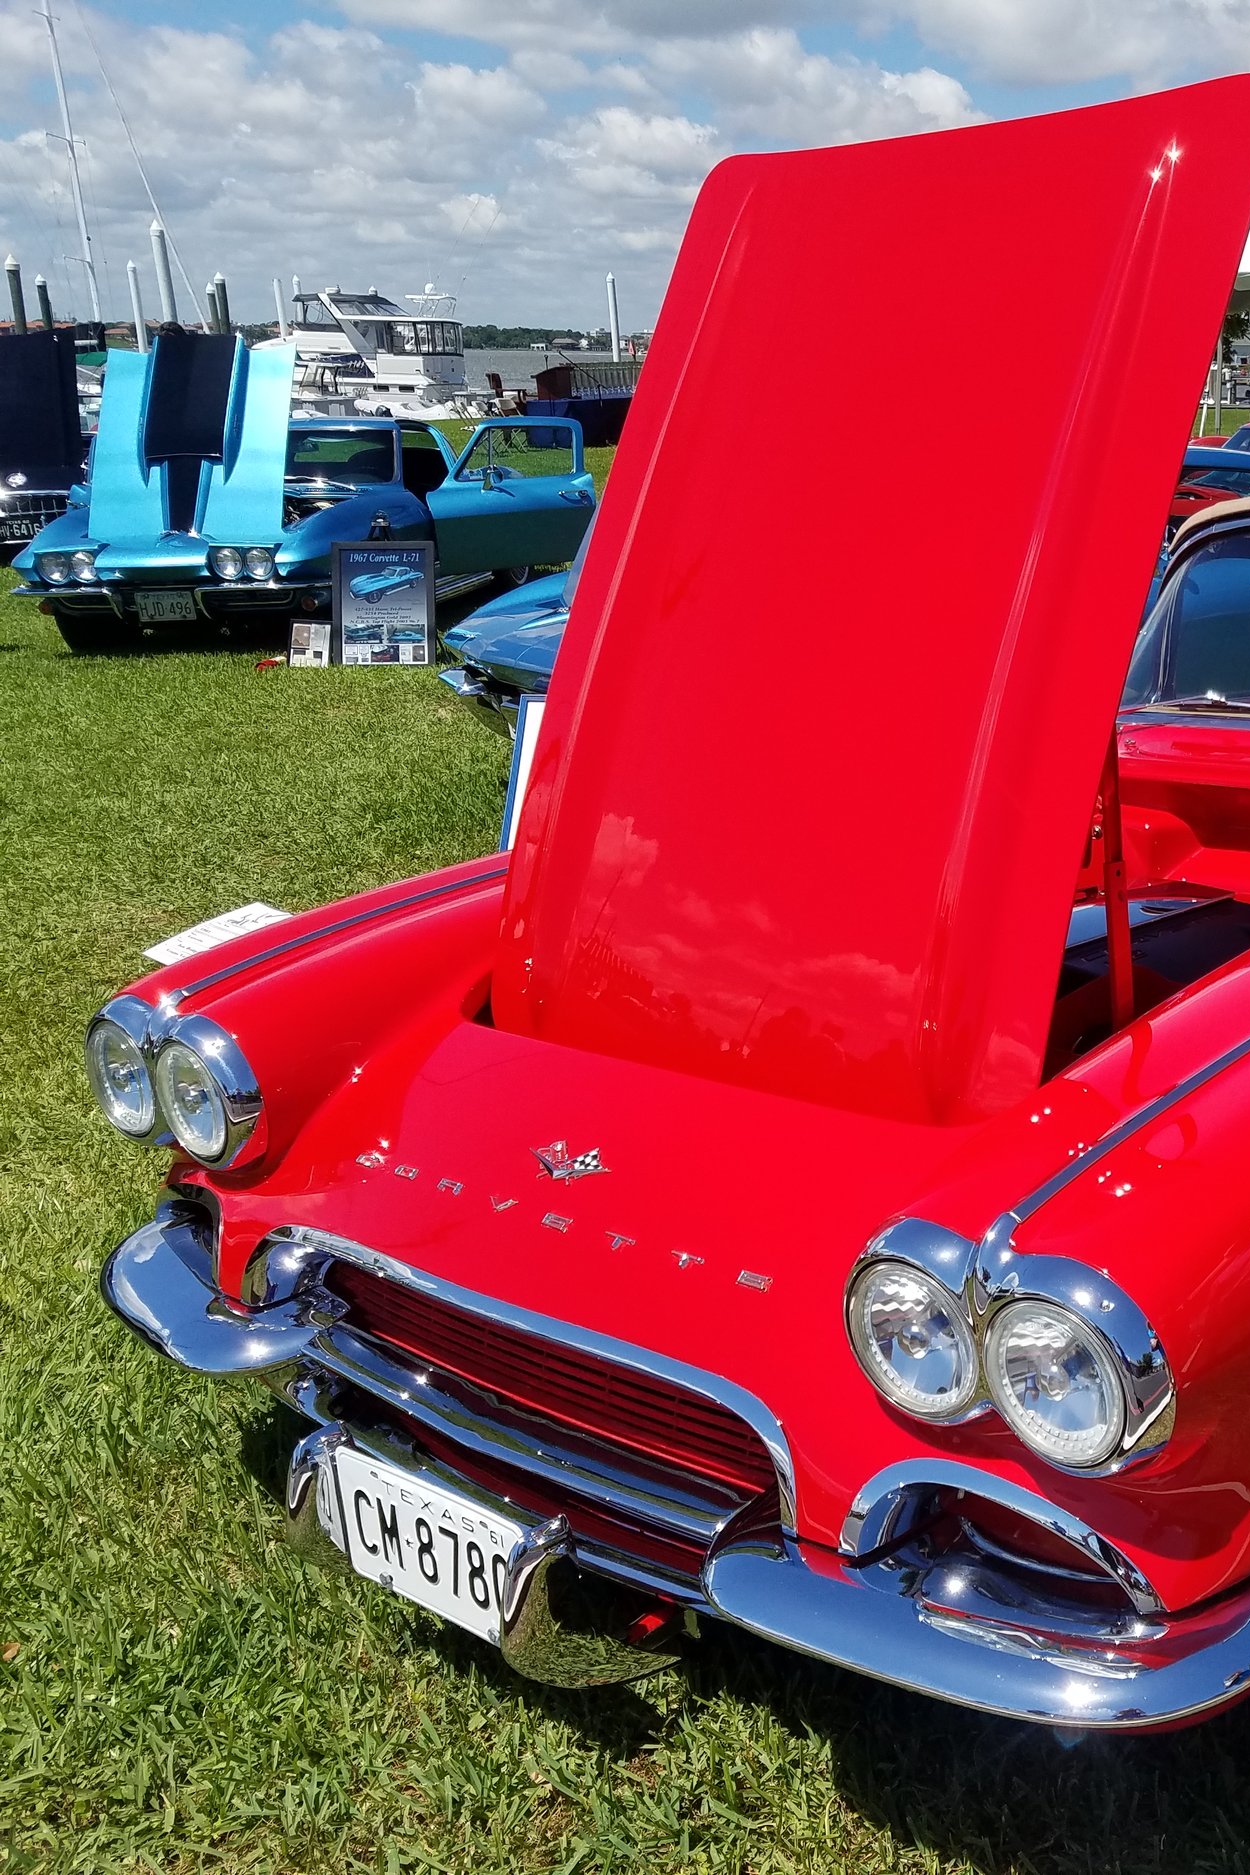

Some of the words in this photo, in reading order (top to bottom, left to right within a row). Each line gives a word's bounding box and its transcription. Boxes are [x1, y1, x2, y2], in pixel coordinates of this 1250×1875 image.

[350, 553, 368, 563] 1967
[369, 553, 399, 563] Corvette
[402, 553, 419, 562] L-71
[356, 1151, 772, 1292] CORVETTE
[381, 1479, 475, 1533] TEXAS
[490, 1530, 505, 1548] 61
